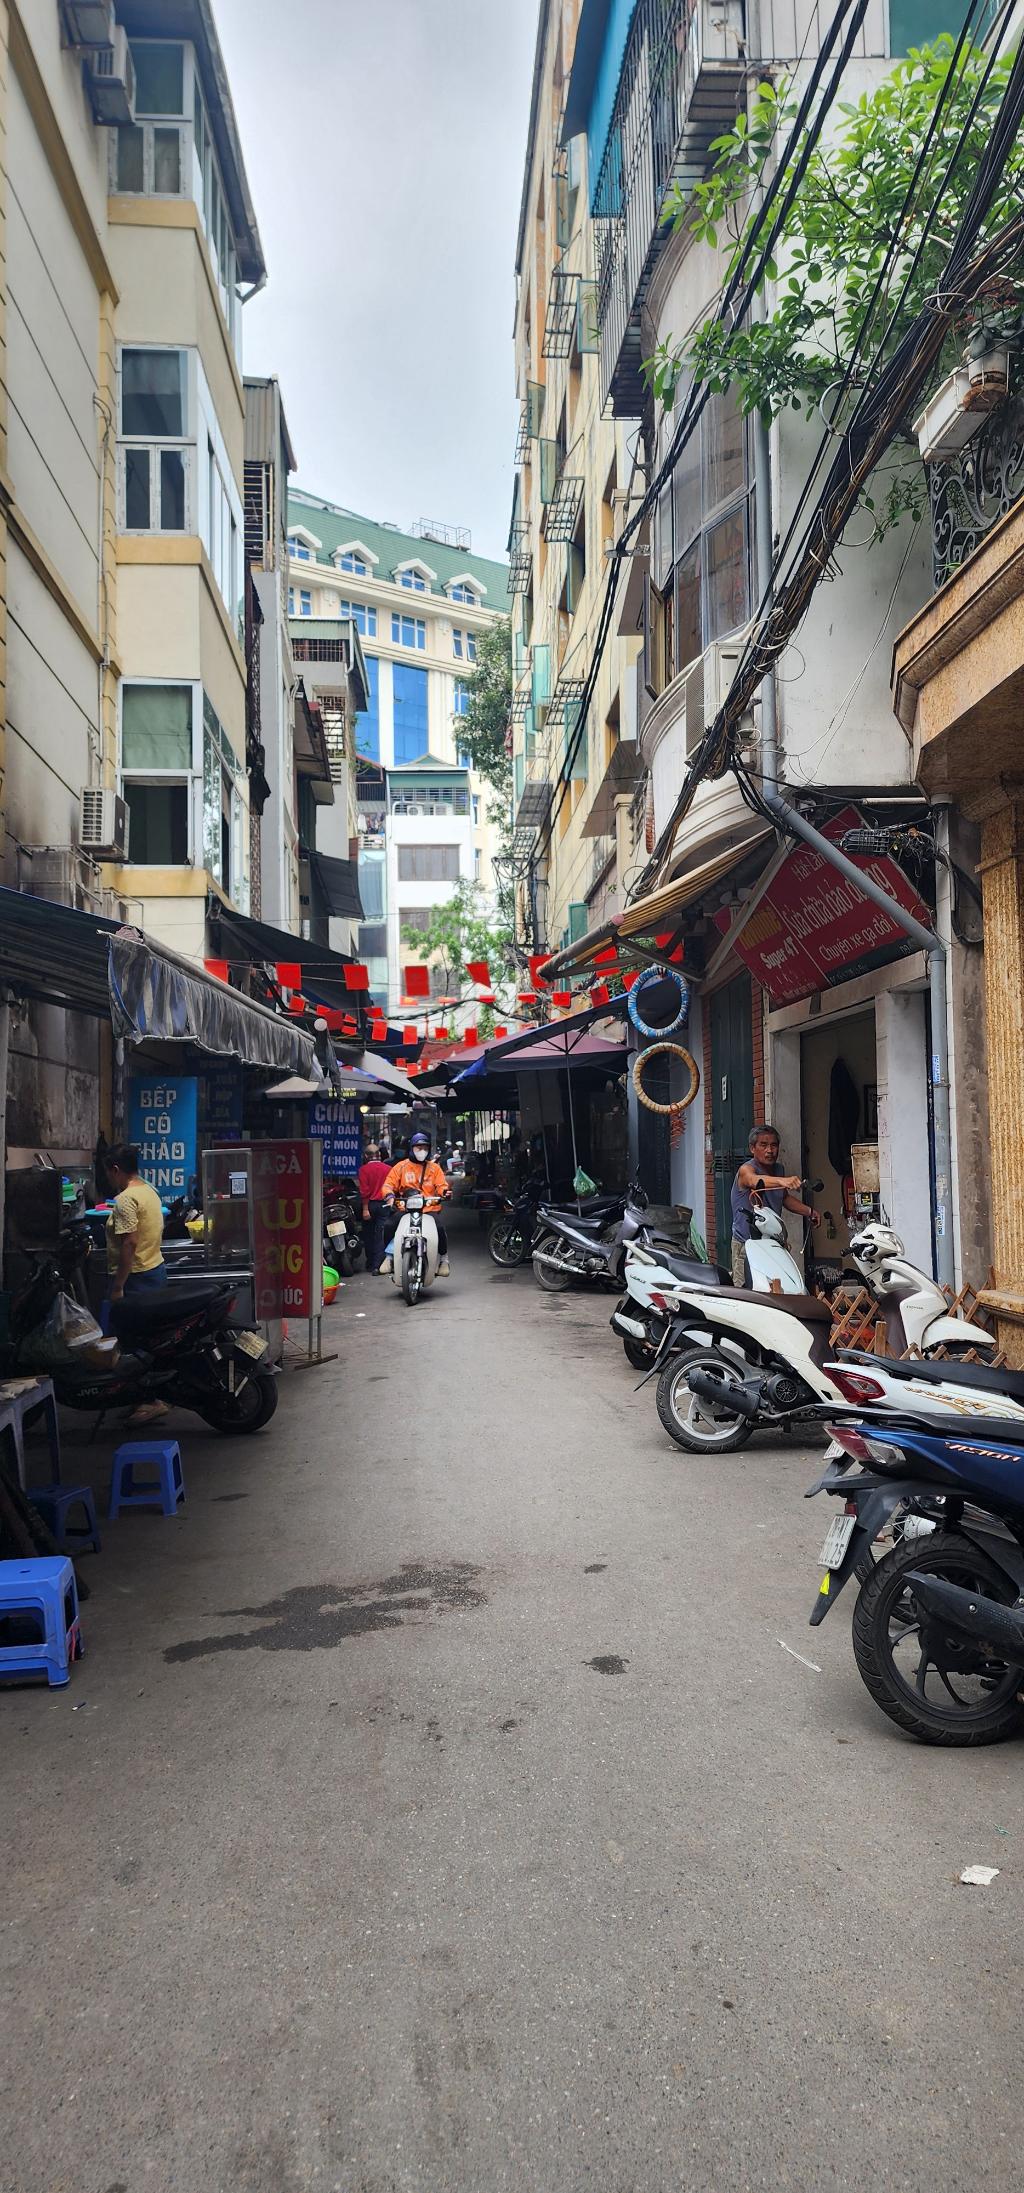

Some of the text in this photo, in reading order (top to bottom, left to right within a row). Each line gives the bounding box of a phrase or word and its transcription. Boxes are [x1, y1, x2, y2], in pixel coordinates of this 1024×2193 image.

[849, 934, 865, 951] xe
[862, 926, 877, 947] ga
[759, 947, 788, 970] Super
[140, 1083, 177, 1108] BẾP
[144, 1112, 171, 1134] CÔ
[337, 1123, 359, 1135] DÂN
[138, 1168, 185, 1187] UNG
